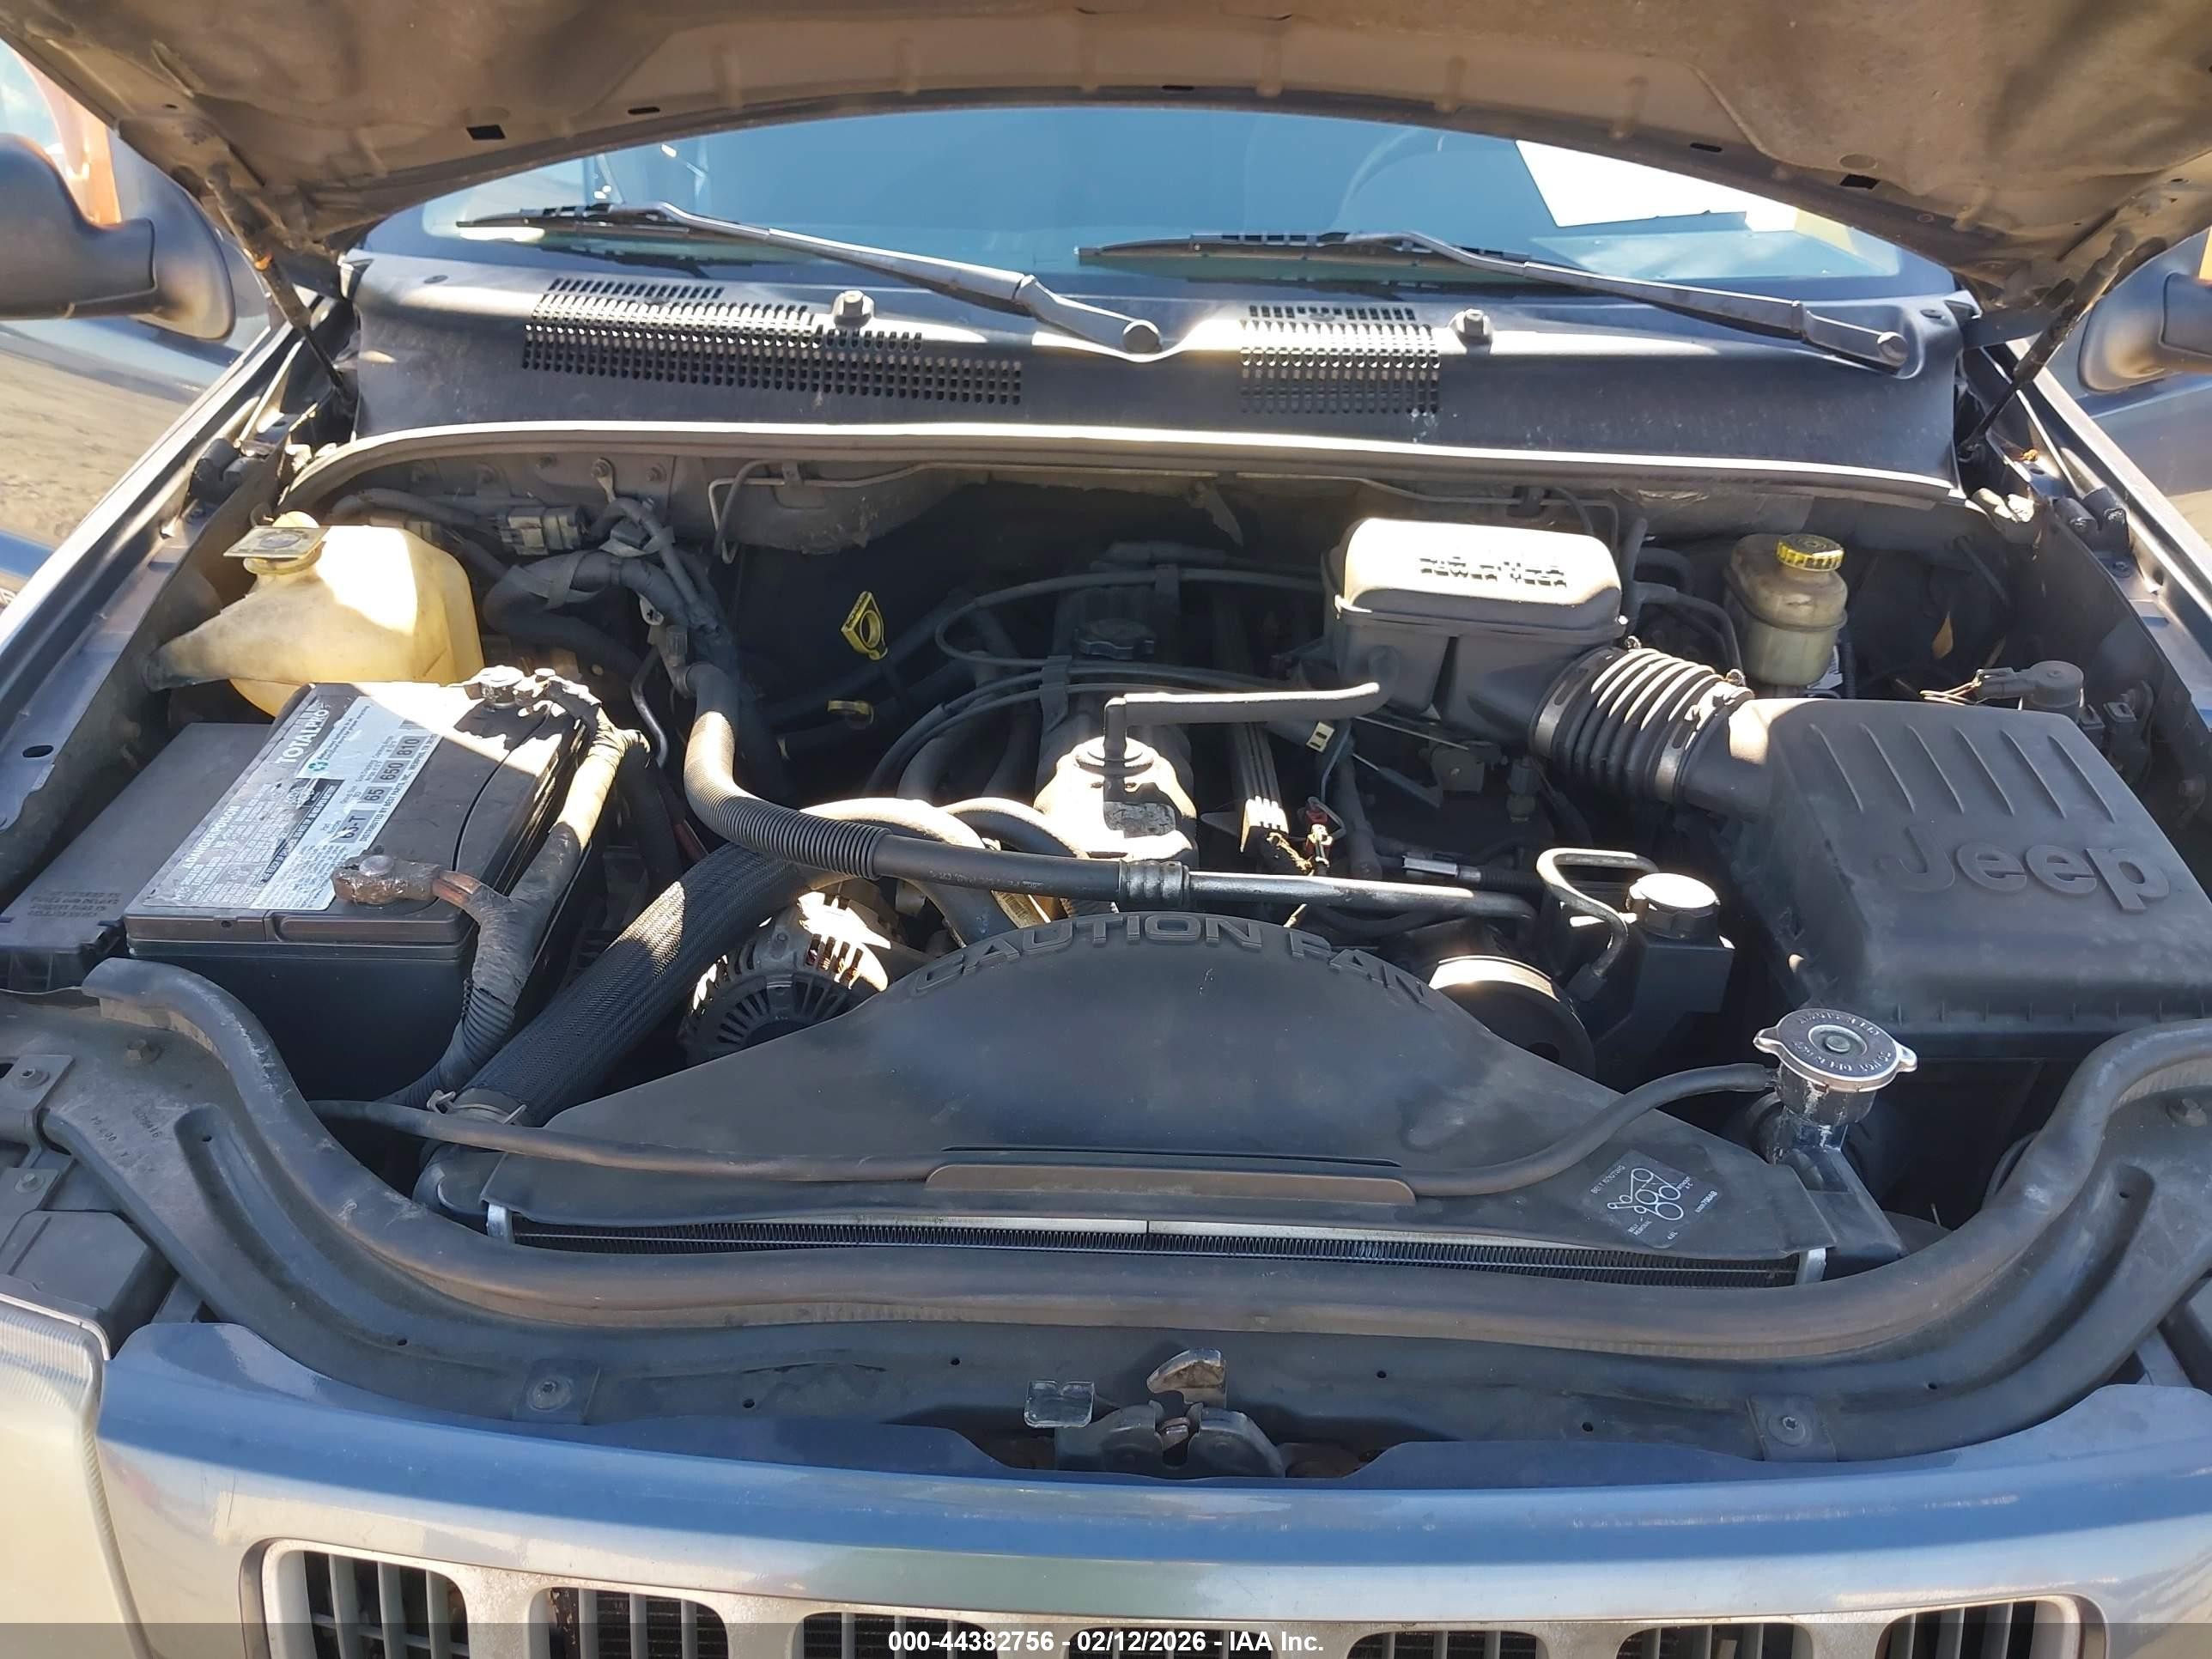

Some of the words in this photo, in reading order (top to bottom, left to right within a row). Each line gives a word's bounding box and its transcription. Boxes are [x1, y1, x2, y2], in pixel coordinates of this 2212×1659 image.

[278, 708, 330, 764] TOTALPRO
[397, 738, 420, 756] 810
[380, 762, 404, 781] 650
[365, 788, 385, 801] 65
[1881, 825, 2170, 913] Jeep
[915, 912, 1262, 994] CAUTION
[1287, 927, 1433, 1006] FAN
